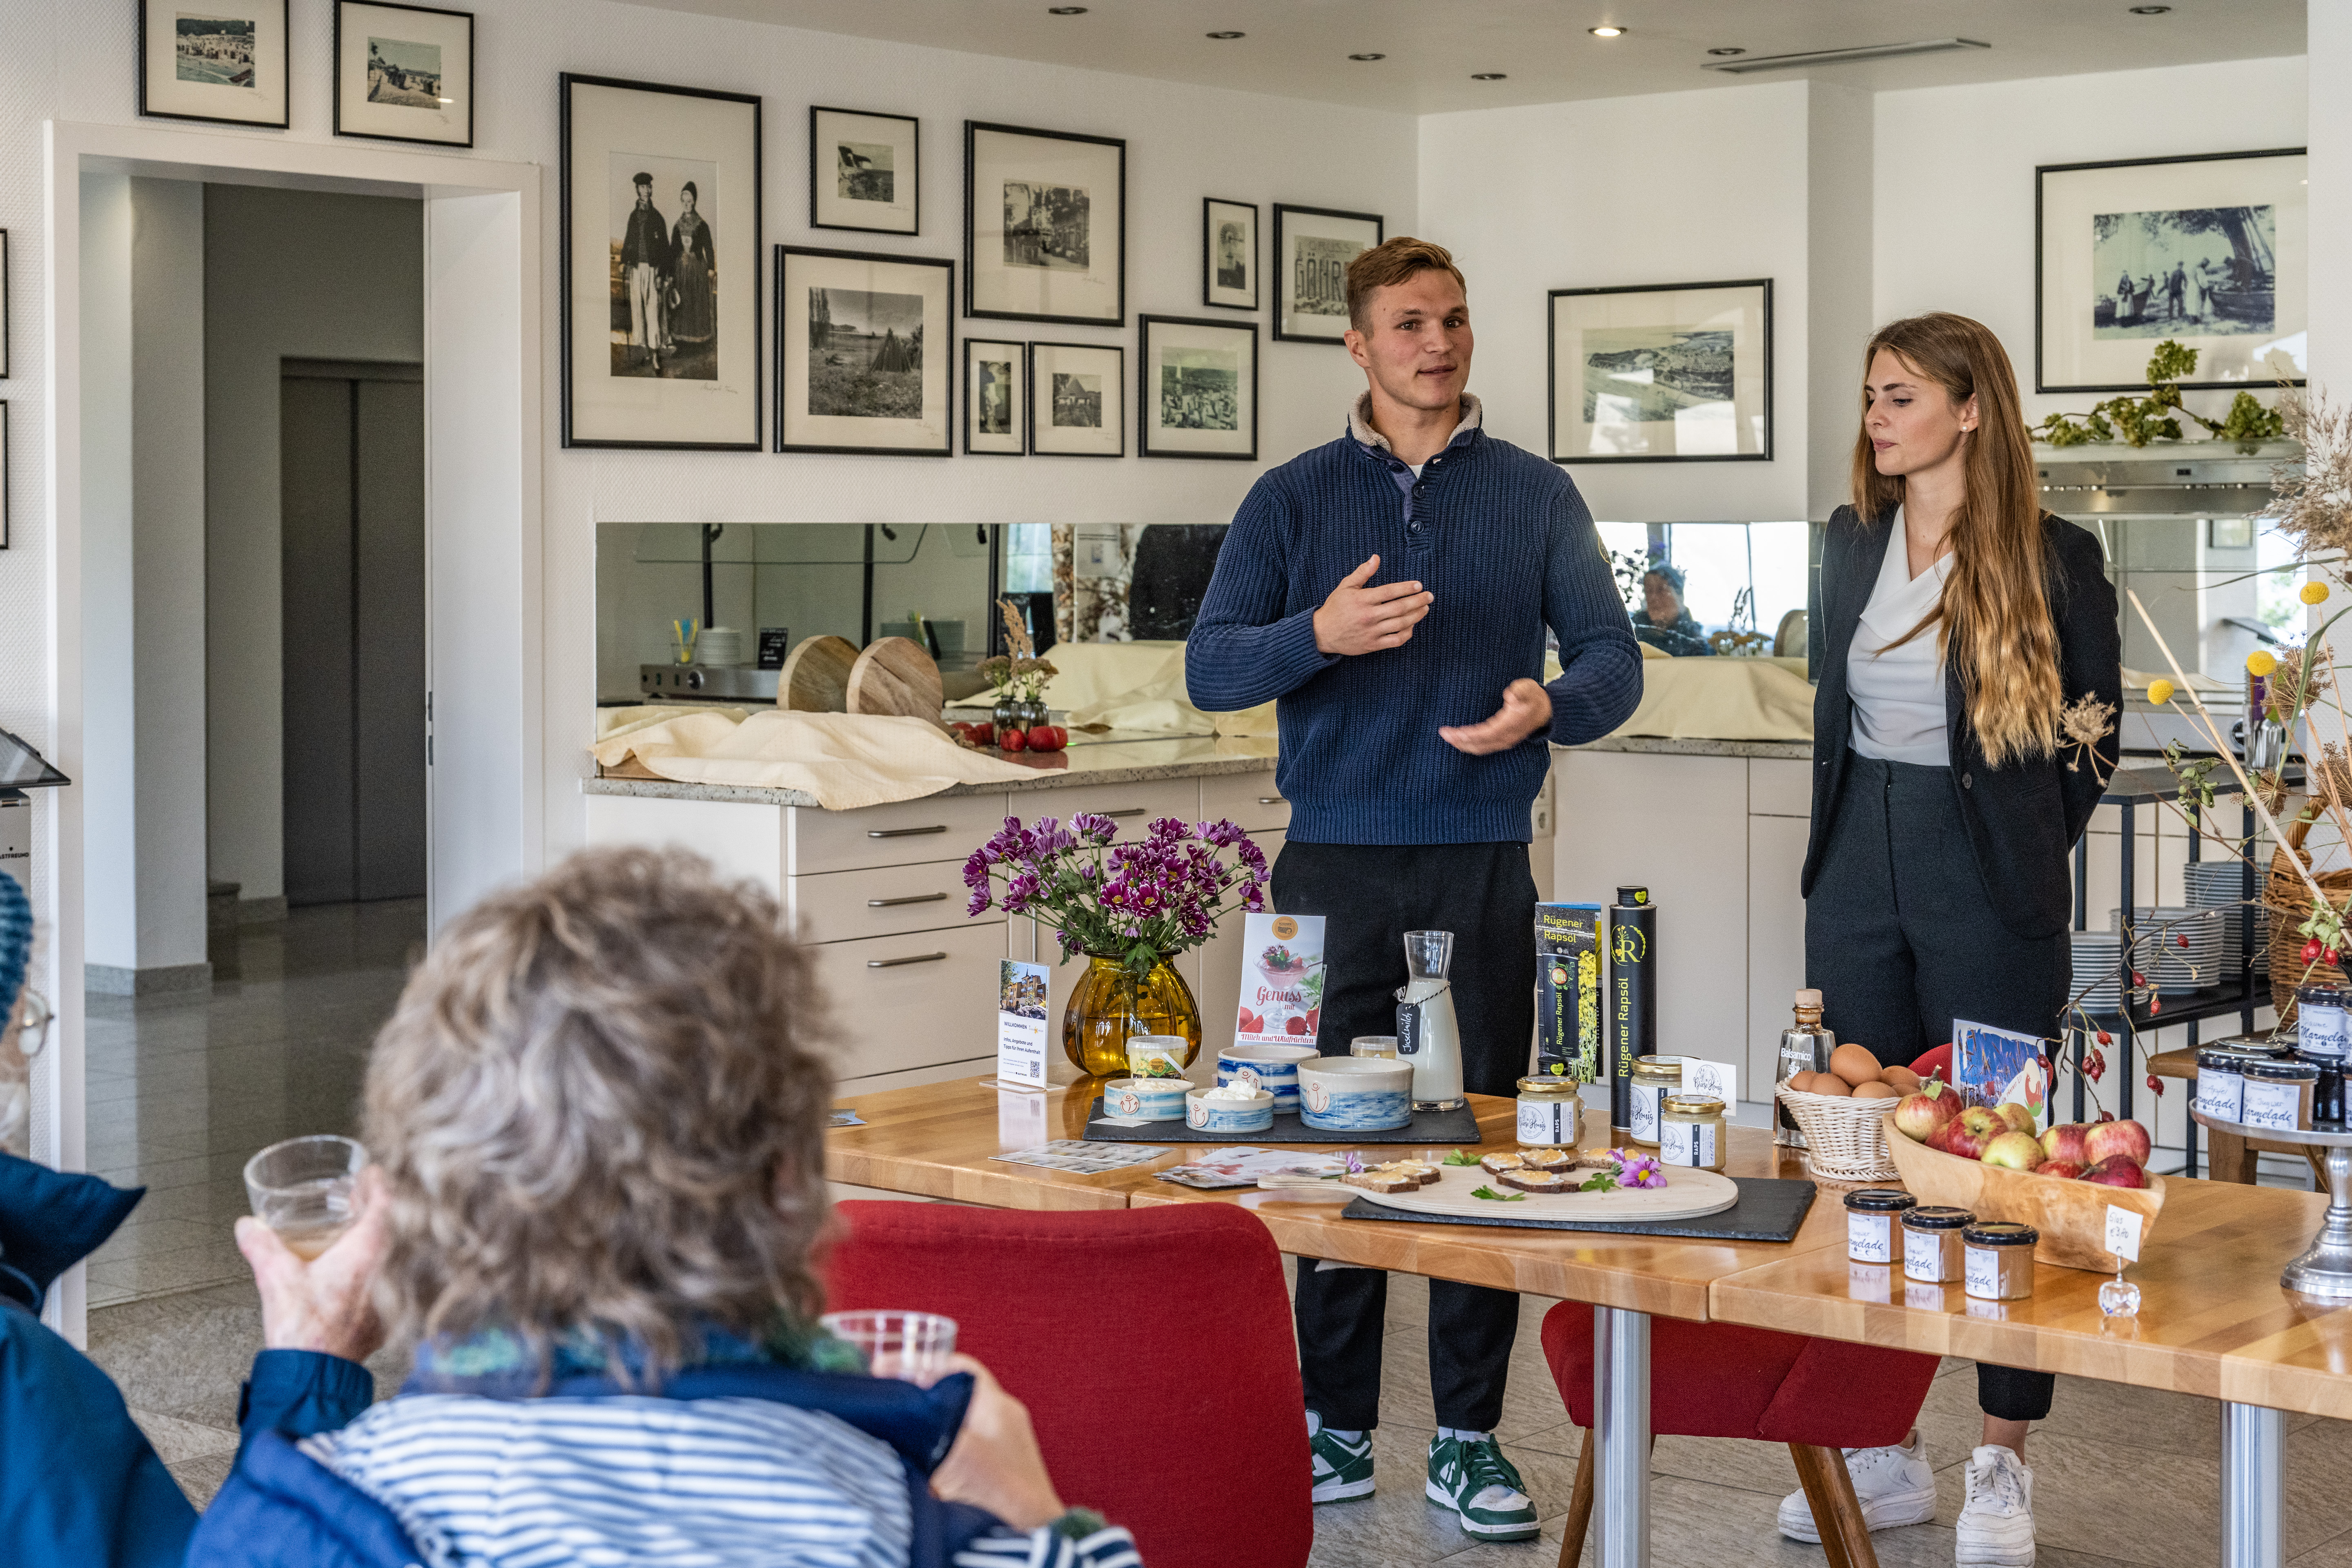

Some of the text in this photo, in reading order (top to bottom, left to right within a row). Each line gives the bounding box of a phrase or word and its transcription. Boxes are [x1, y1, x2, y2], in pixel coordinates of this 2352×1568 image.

[1544, 915, 1583, 928] Rügener
[1544, 930, 1576, 943] Rapsöl
[1619, 940, 1640, 962] R
[1256, 986, 1301, 1006] Genuss
[1401, 1013, 1412, 1052] Inselmilch
[1618, 978, 1632, 1077] Rügener Rapsöl
[1274, 1036, 1314, 1044] Wildfrüchten
[1708, 1079, 1722, 1094] Honig
[1635, 1105, 1654, 1125] Honig
[1529, 1118, 1546, 1131] Honig
[1669, 1139, 1684, 1153] Honig
